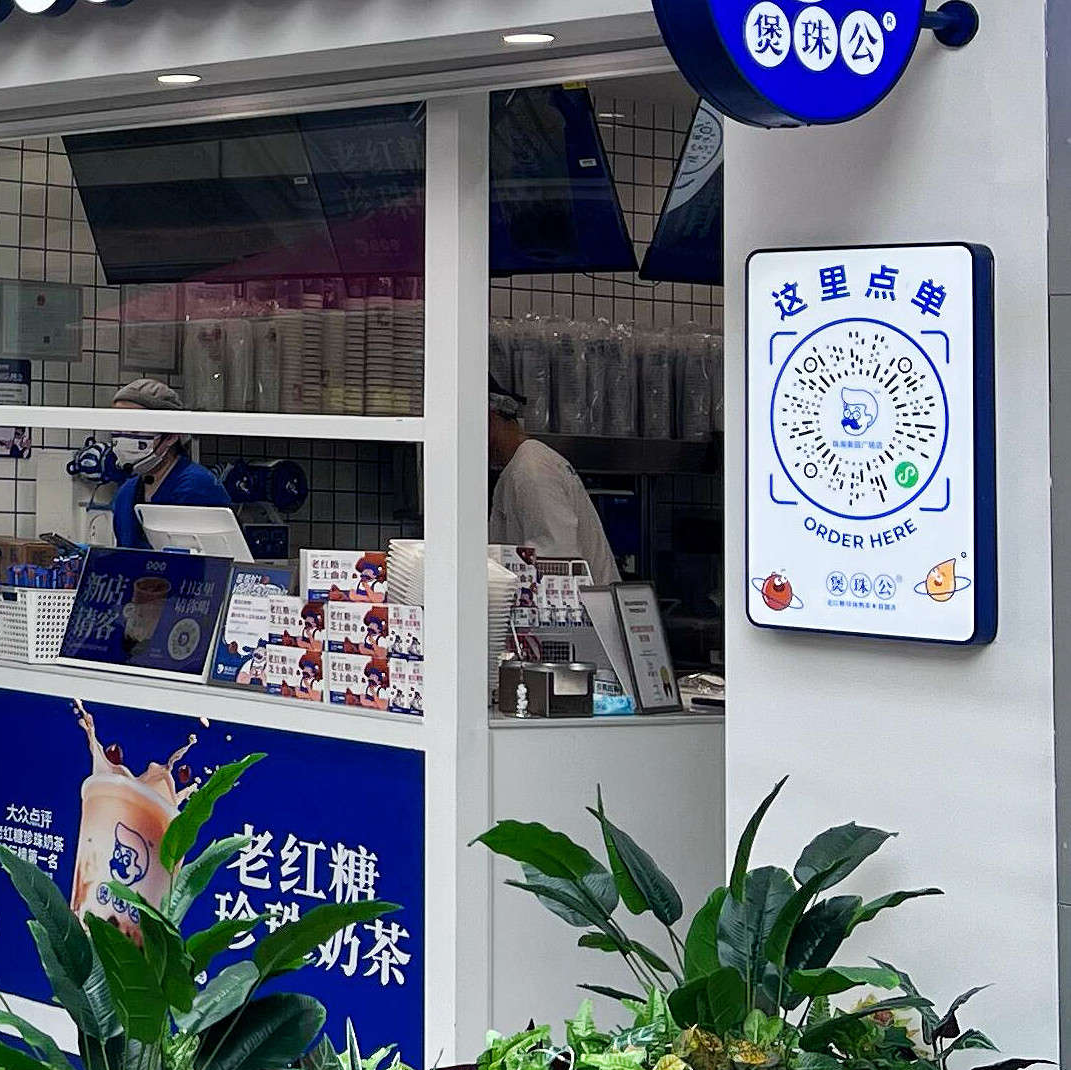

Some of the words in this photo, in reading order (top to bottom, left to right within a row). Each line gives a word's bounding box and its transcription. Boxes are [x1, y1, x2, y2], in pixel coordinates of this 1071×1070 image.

[748, 6, 881, 68] 煲珠公
[771, 264, 948, 321] 这里点单
[803, 516, 864, 549] ORDER
[870, 518, 918, 549] HERE
[5, 803, 53, 829] 大众点评
[226, 823, 381, 904] 老红糖
